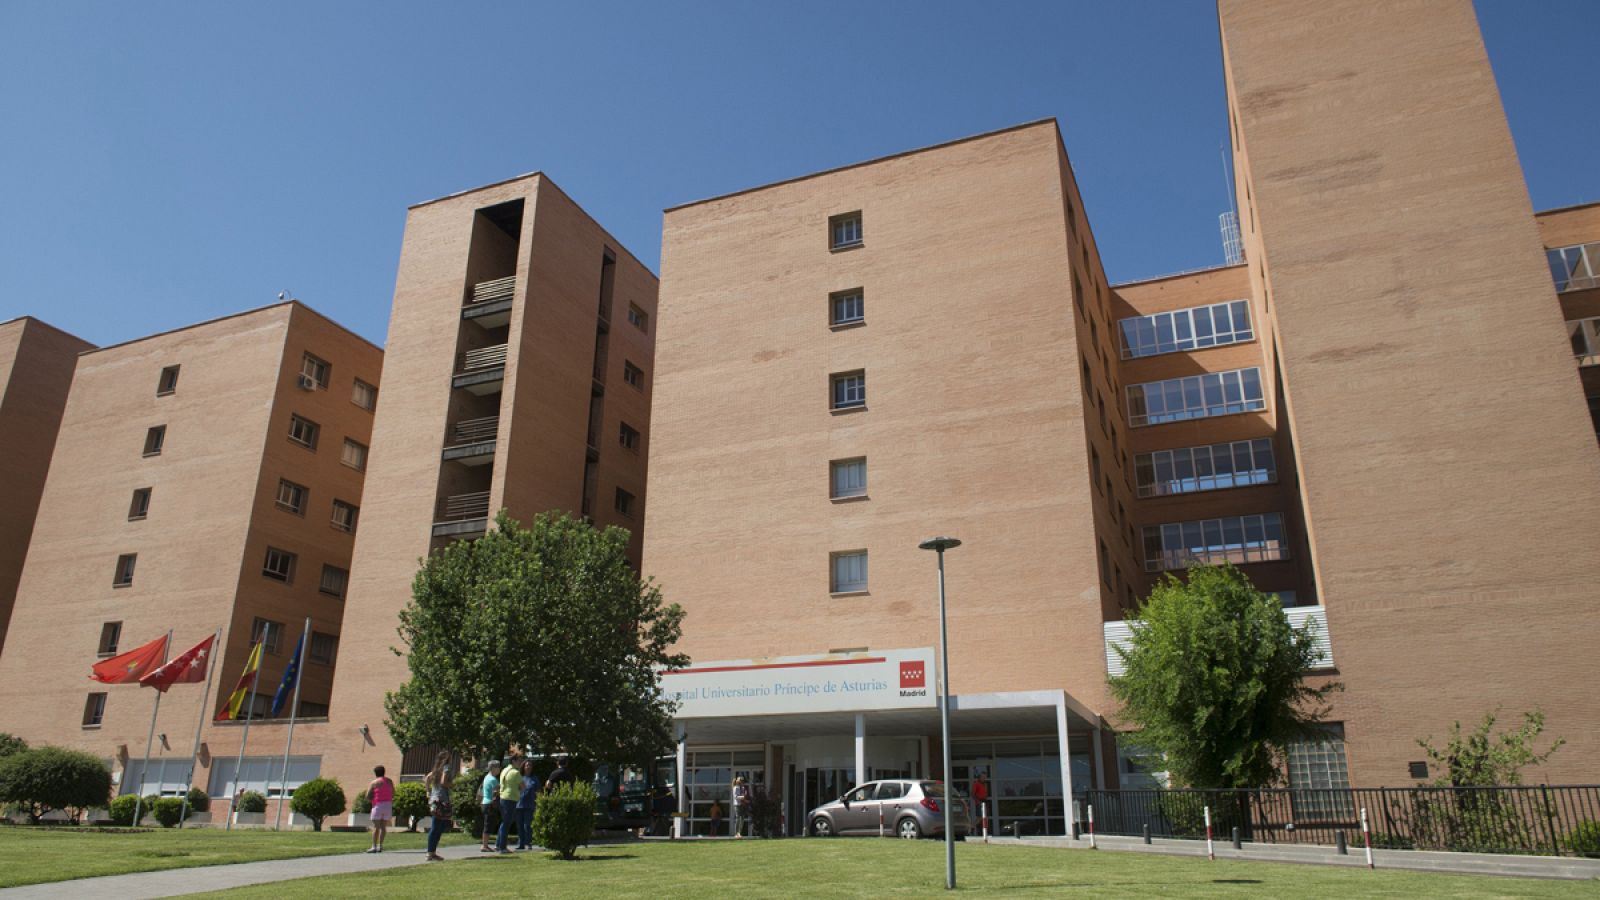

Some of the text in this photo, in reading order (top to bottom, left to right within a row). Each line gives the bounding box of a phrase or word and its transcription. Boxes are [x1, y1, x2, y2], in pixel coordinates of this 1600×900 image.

[702, 685, 770, 699] Universitario
[775, 681, 820, 697] Príncipe
[823, 680, 837, 692] de
[841, 678, 888, 692] Asturias
[900, 689, 926, 697] Madrid
